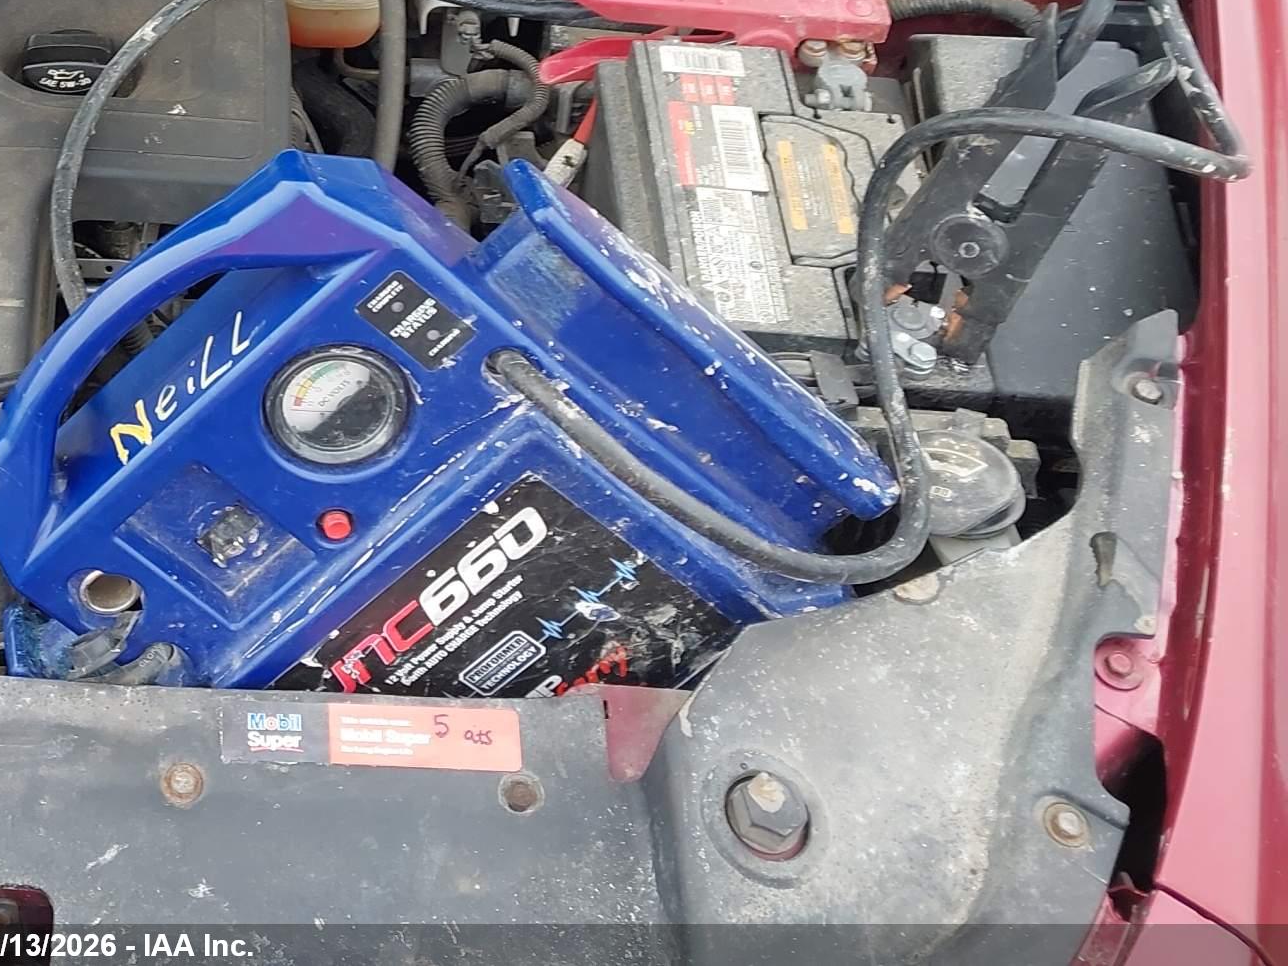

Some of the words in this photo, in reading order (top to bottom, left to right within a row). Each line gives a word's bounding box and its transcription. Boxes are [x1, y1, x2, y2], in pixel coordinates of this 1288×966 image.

[367, 280, 400, 309] CHARGING
[389, 297, 437, 338] CHARGING
[400, 306, 438, 339] STATUS
[428, 328, 461, 357] CHARGING
[410, 643, 439, 666] Power
[436, 621, 466, 646] Supply
[462, 616, 473, 624] &
[471, 598, 497, 618] Jump
[492, 575, 524, 600] Starter
[426, 650, 449, 669] AUTO
[444, 624, 480, 652] CHARGE
[475, 591, 524, 628] Technology
[469, 637, 526, 682] PROFORMER
[482, 645, 538, 690] TECHNOLOGY
[247, 712, 302, 733] Mobil
[434, 714, 450, 738] 5
[247, 731, 302, 751] Super
